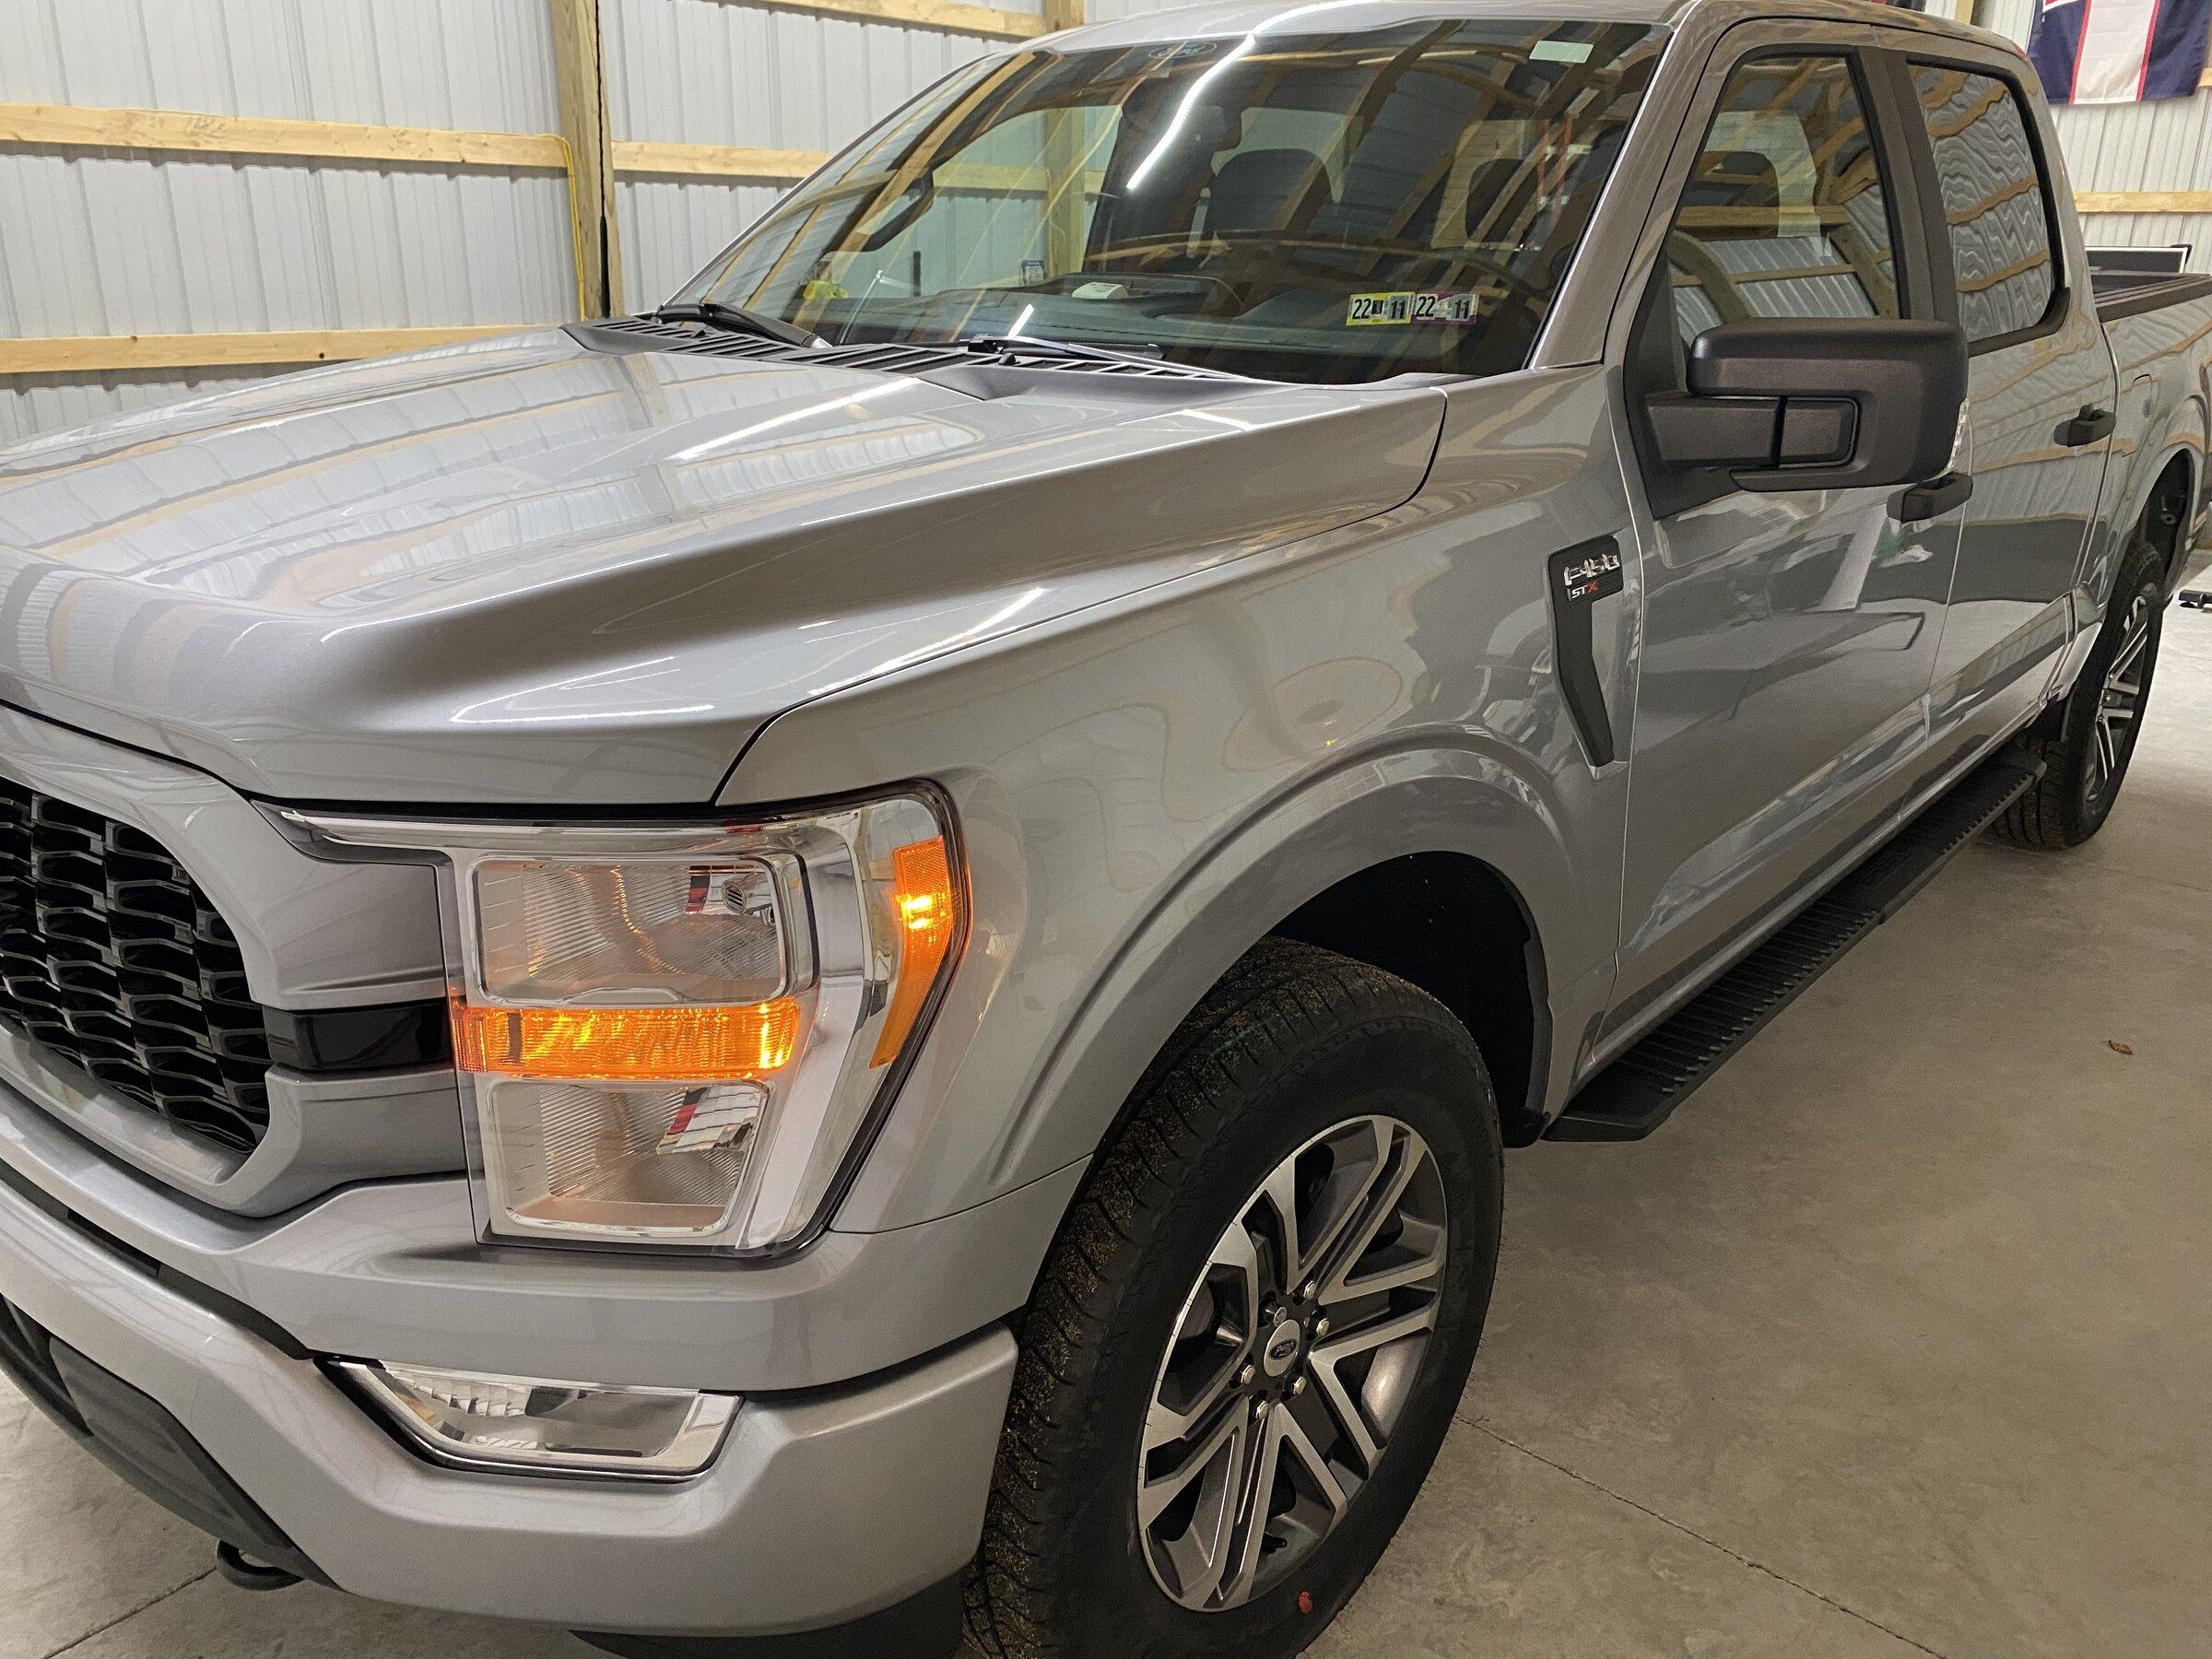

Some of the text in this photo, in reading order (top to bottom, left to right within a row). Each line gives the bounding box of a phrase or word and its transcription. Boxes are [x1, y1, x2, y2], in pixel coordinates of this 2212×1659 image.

[1352, 299, 1406, 320] 22 11
[1416, 296, 1471, 319] 22 11
[1571, 581, 1598, 599] STX
